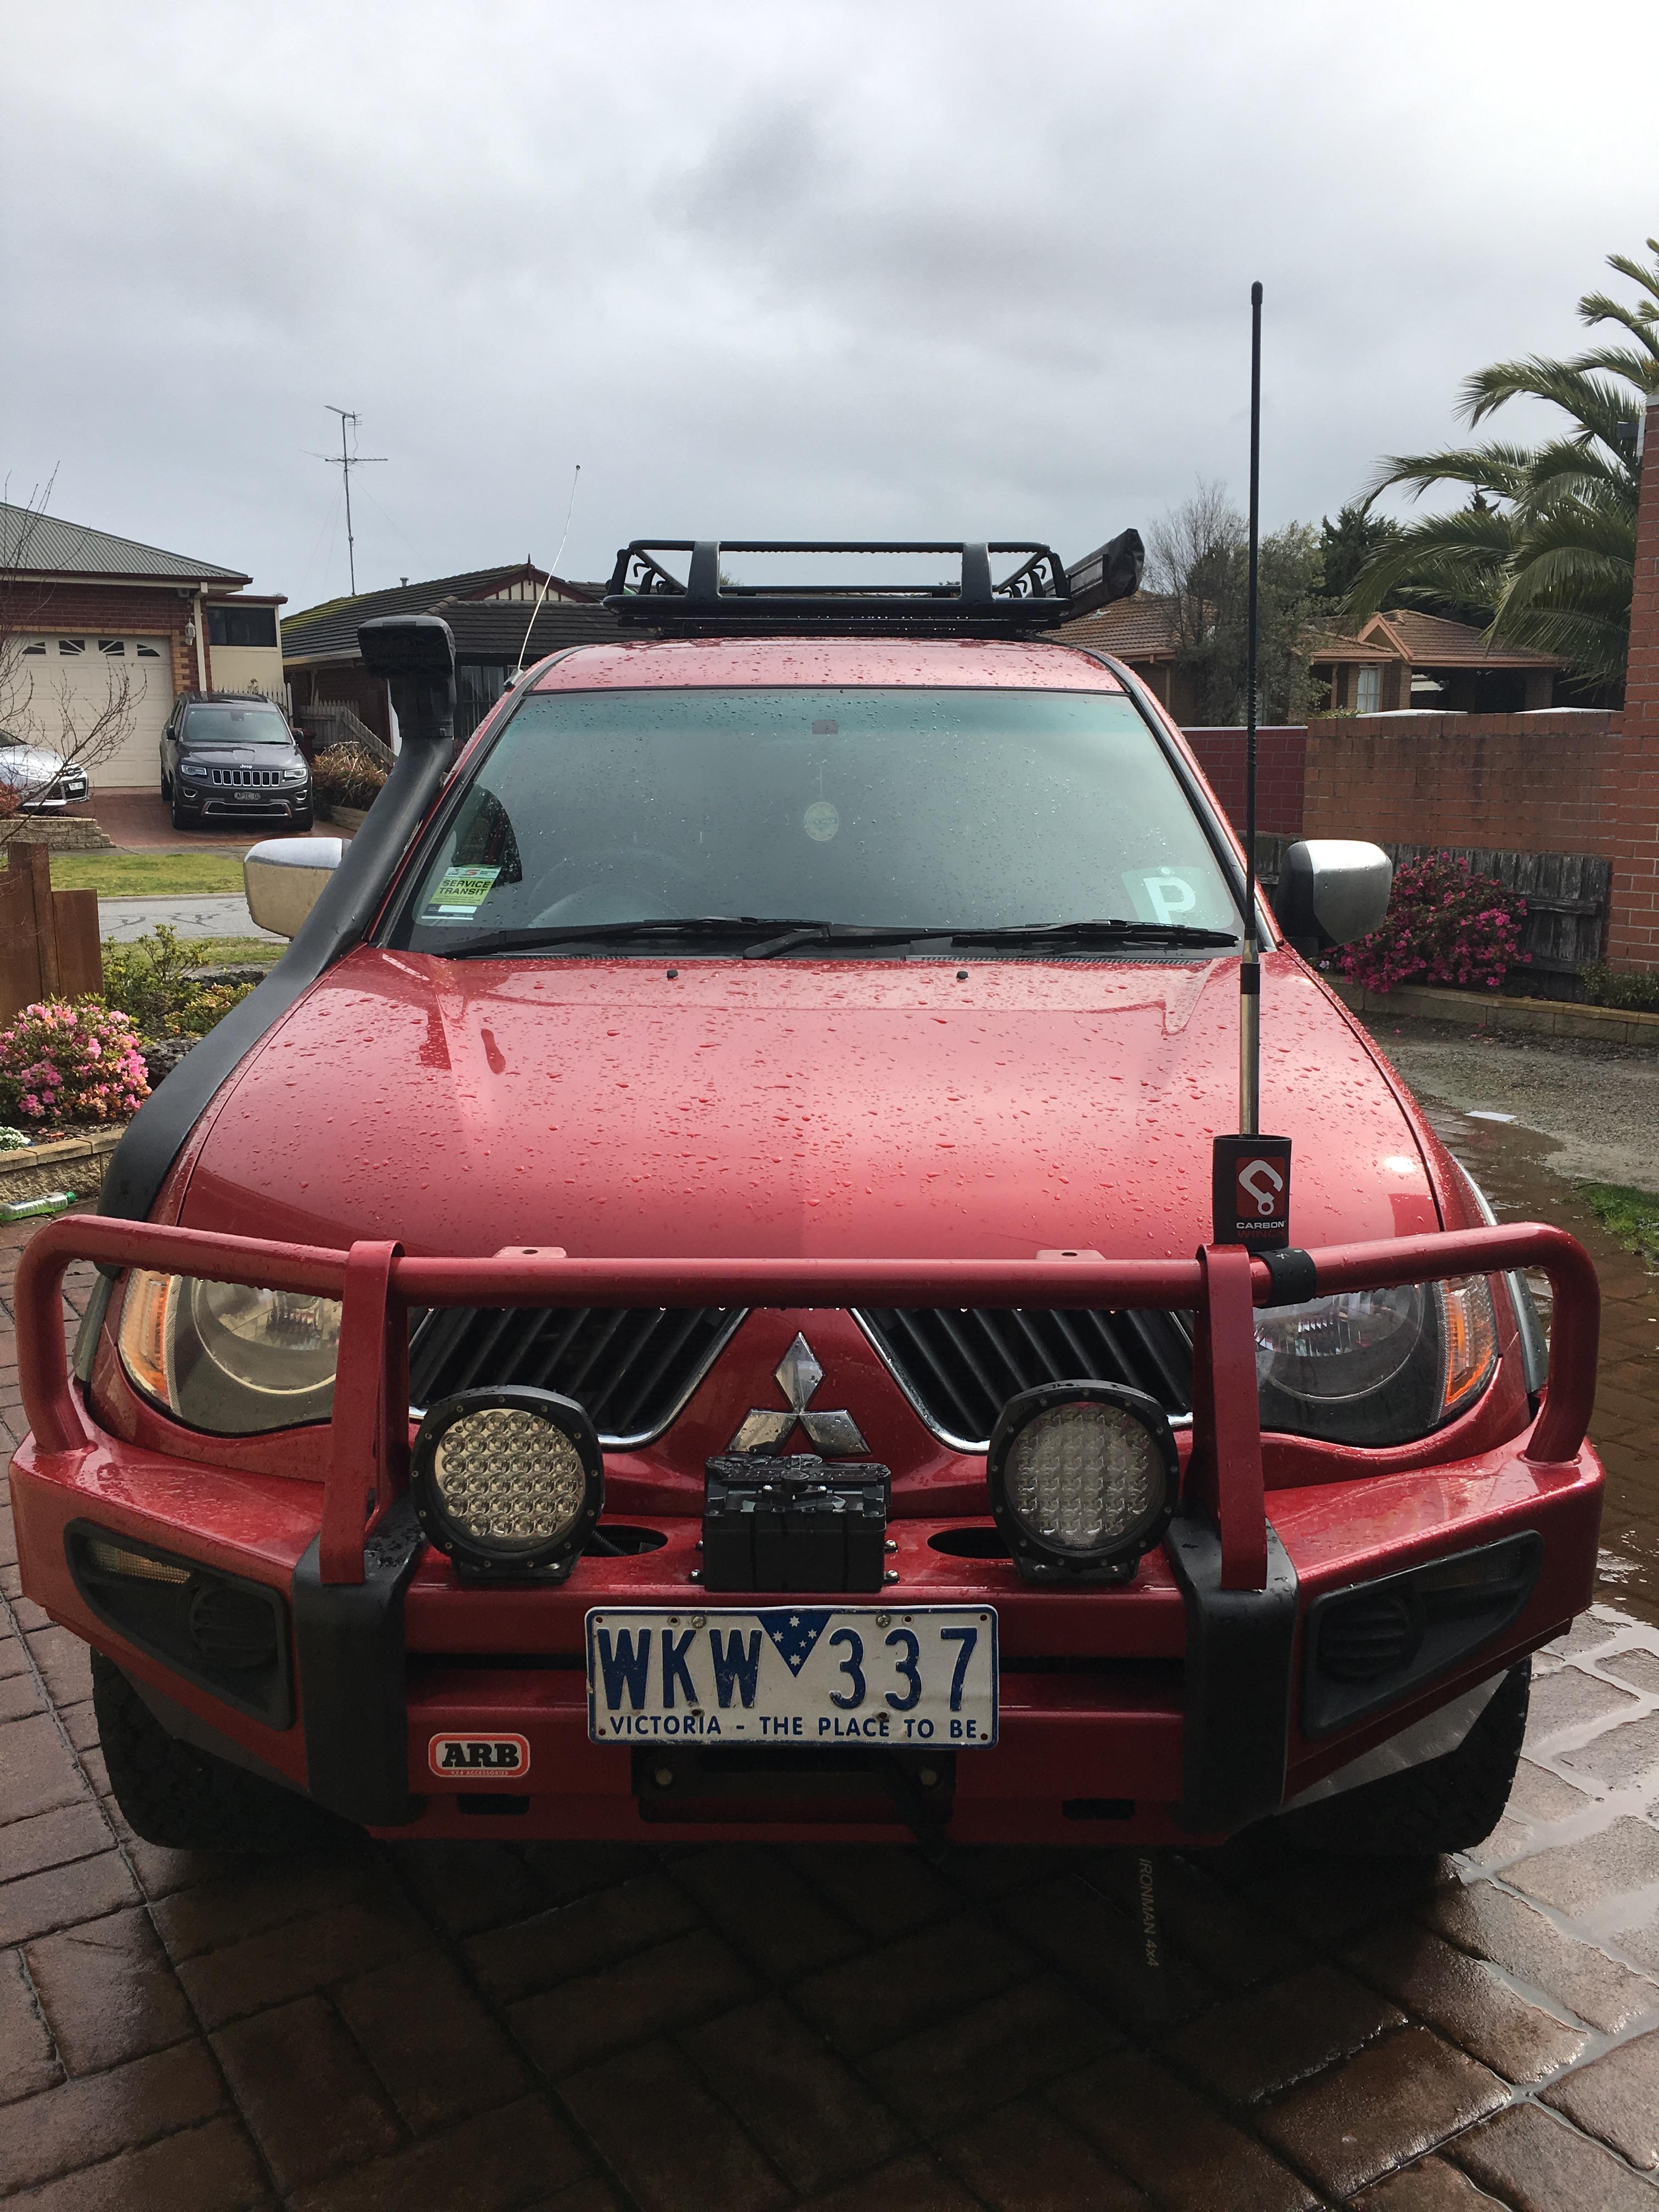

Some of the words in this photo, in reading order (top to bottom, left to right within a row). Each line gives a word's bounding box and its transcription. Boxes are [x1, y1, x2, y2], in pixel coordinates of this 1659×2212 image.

[439, 887, 487, 895] TRANSIT
[442, 879, 491, 888] SERVICE
[1143, 877, 1196, 924] P
[597, 1628, 763, 1710] WKW
[829, 1627, 978, 1712] 337
[610, 1716, 721, 1735] VICTORIA
[760, 1717, 803, 1736] THE
[819, 1717, 889, 1737] PLACE
[904, 1719, 934, 1739] TO
[950, 1719, 977, 1739] BE
[442, 1743, 519, 1768] ARB
[1138, 1858, 1156, 1934] IRONMAN
